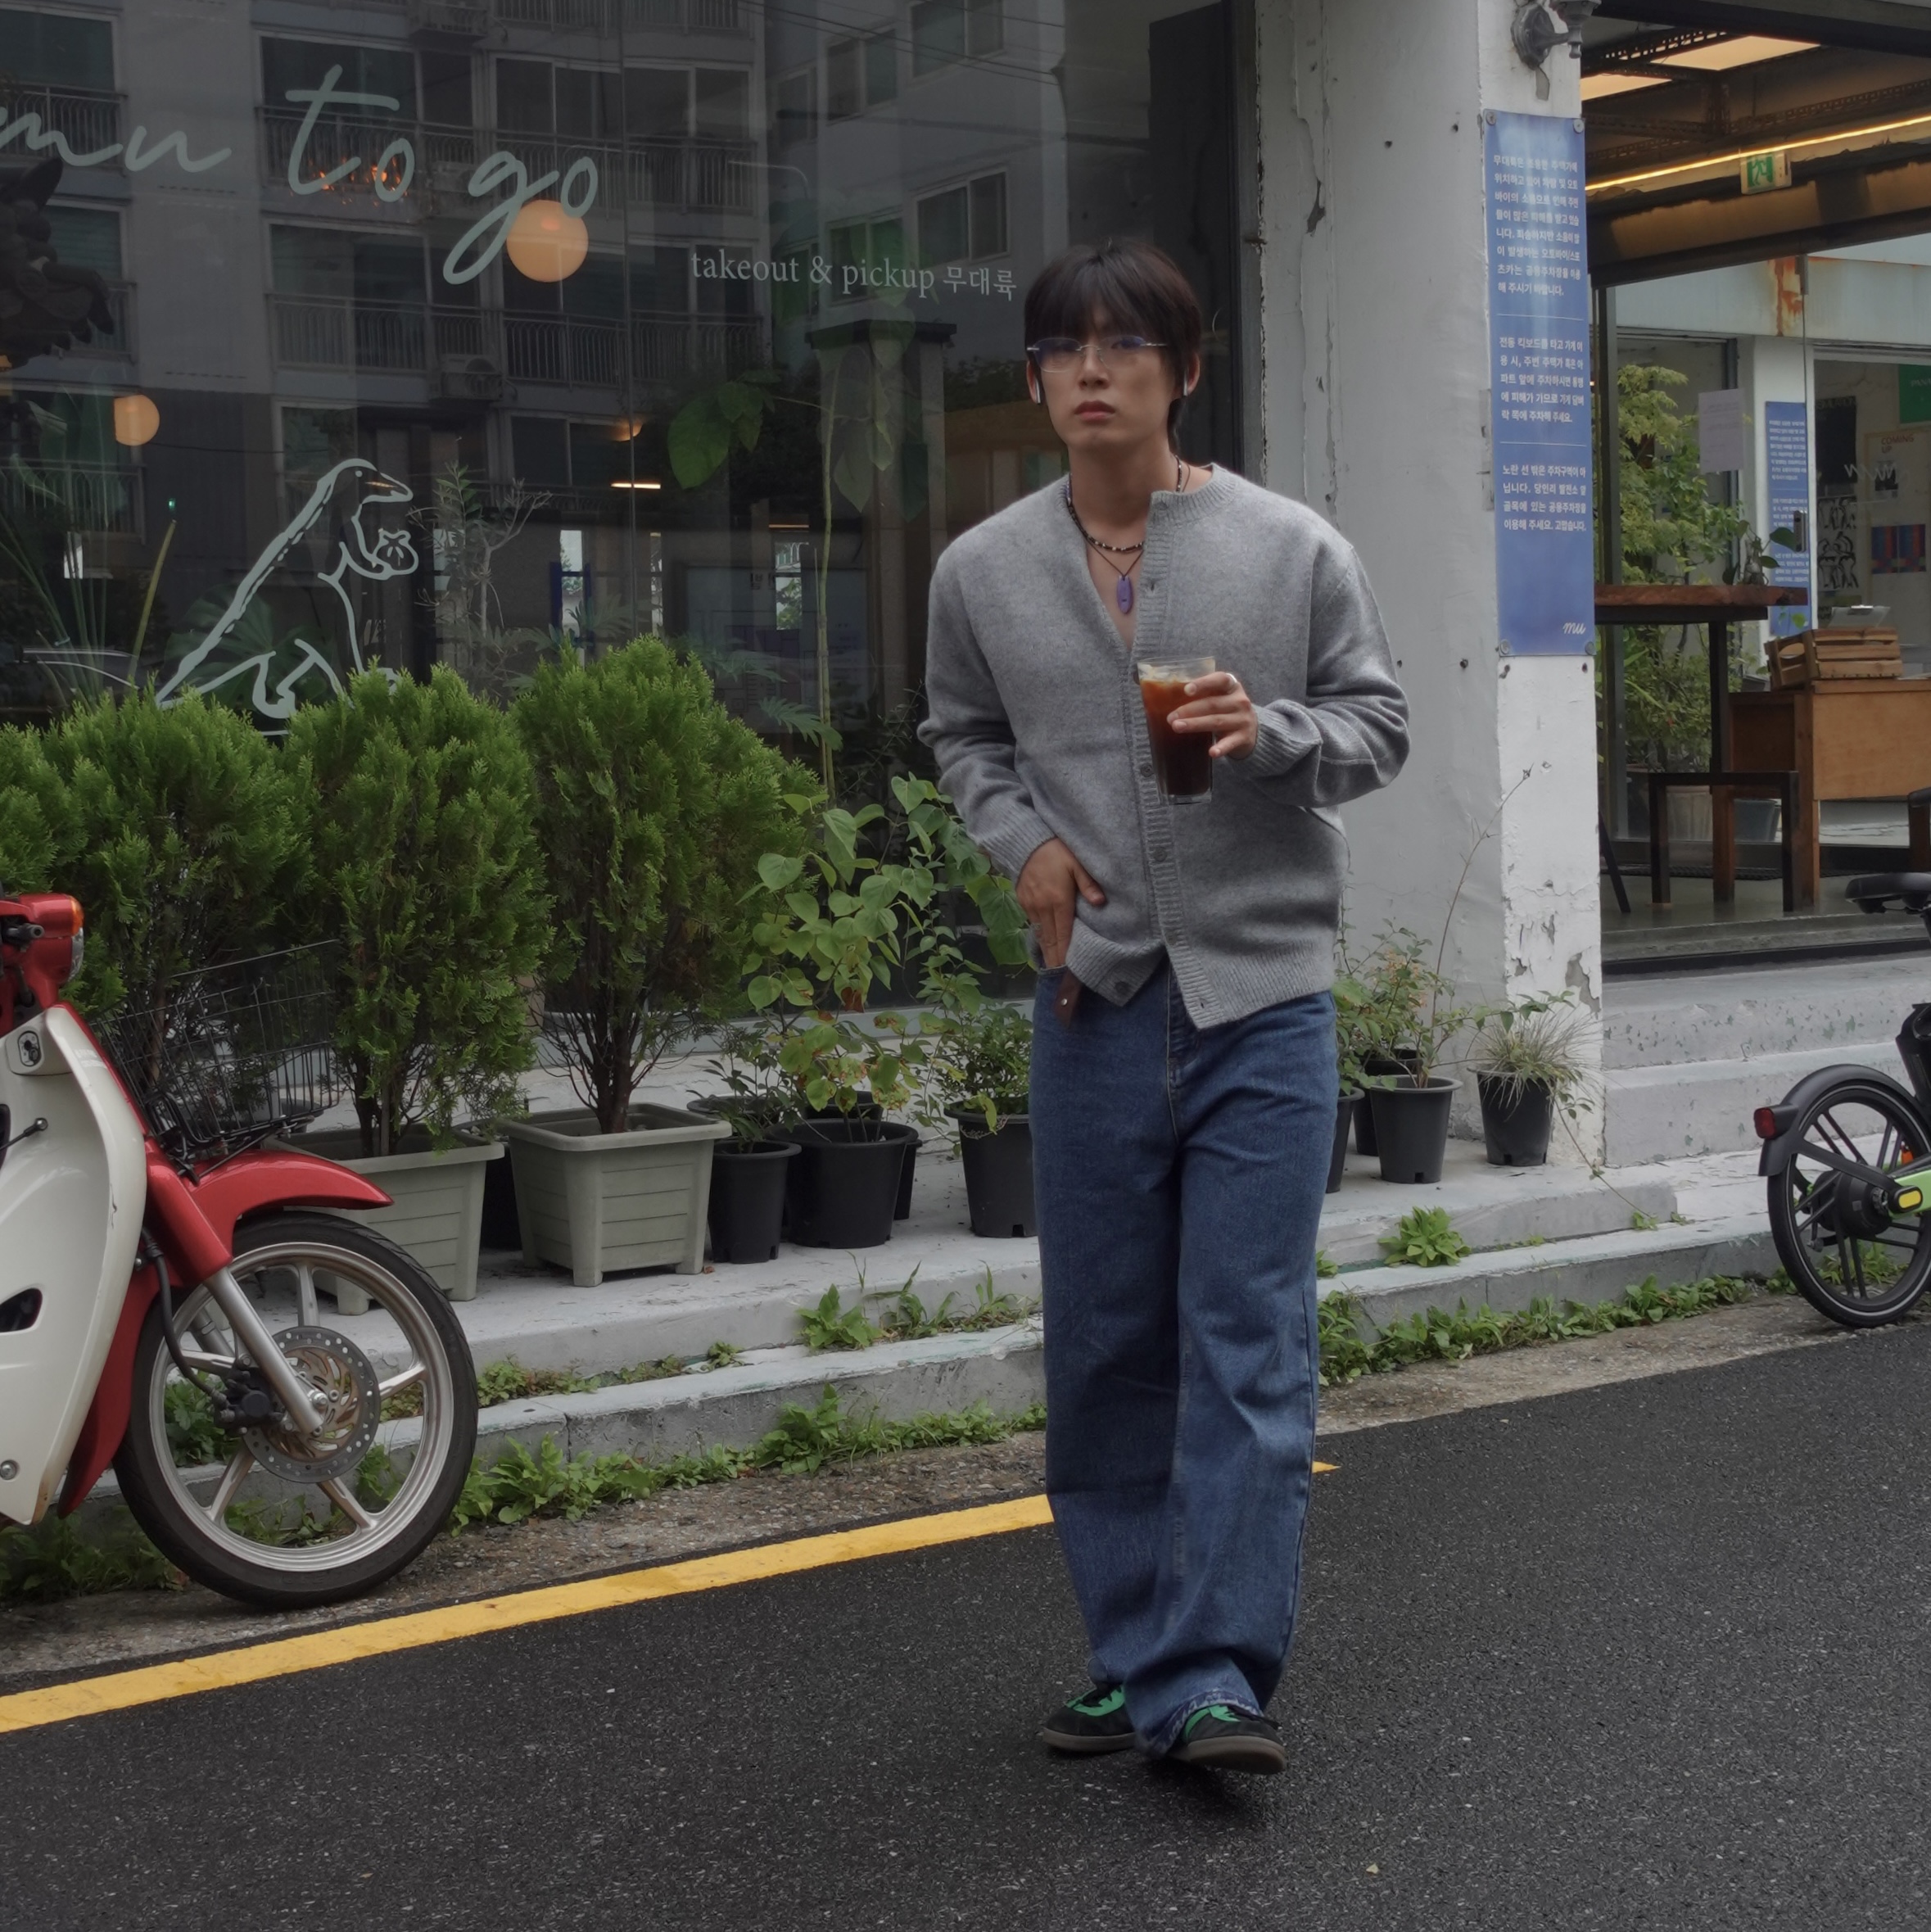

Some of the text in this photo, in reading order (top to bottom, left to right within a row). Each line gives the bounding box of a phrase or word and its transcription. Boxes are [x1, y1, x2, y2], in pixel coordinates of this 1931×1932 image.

[286, 64, 415, 202] to
[442, 150, 599, 285] go
[1495, 174, 1524, 185] 위치하고
[1559, 179, 1566, 189] 및
[1567, 180, 1577, 189] 오토
[1495, 192, 1518, 203] 바이의
[1522, 194, 1550, 205] 소음으로
[1553, 196, 1567, 206] 인해
[1513, 210, 1528, 222] 많은
[1531, 212, 1553, 224] 피해를
[1555, 214, 1568, 224] 받고
[1496, 228, 1514, 238] 니다.
[1517, 229, 1553, 242] 죄송하지만
[1556, 232, 1573, 242] 소음이
[1497, 246, 1580, 261] 이 발생하는 오토바이/스포
[691, 249, 1017, 301] takeout & pickup 무대륙
[1497, 265, 1581, 280] 츠카는 공용주차장을 이용
[1498, 282, 1564, 296] 해 주시기 바랍니다.
[1499, 337, 1582, 351] 전동 킥보드를 타고 가게 이
[1500, 355, 1508, 366] 용
[1511, 355, 1522, 368] 시,
[1543, 357, 1563, 368] 주택가
[1565, 359, 1576, 369] 혹은
[1577, 360, 1583, 370] 아
[1500, 373, 1584, 387] 파트 앞에 주차하시면 통행
[1501, 391, 1508, 402] 에
[1512, 392, 1533, 403] 피해가
[1560, 394, 1571, 405] 가게
[1572, 396, 1584, 405] 담벼
[1501, 410, 1572, 423] 락 쪽에 주차해 주세요.
[1881, 433, 1915, 445] COMING
[1882, 446, 1893, 454] UP
[1503, 464, 1585, 477] 노란 선 밖은 주차구역이 아
[1503, 482, 1531, 494] 닙니다.
[1534, 483, 1556, 495] 당인리
[1559, 484, 1578, 495] 발전소
[1504, 501, 1586, 514] 골목에 있는 공용주차장을
[1504, 519, 1586, 532] 이용해 주세요. 고맙습니다.
[1562, 622, 1587, 635] mu
